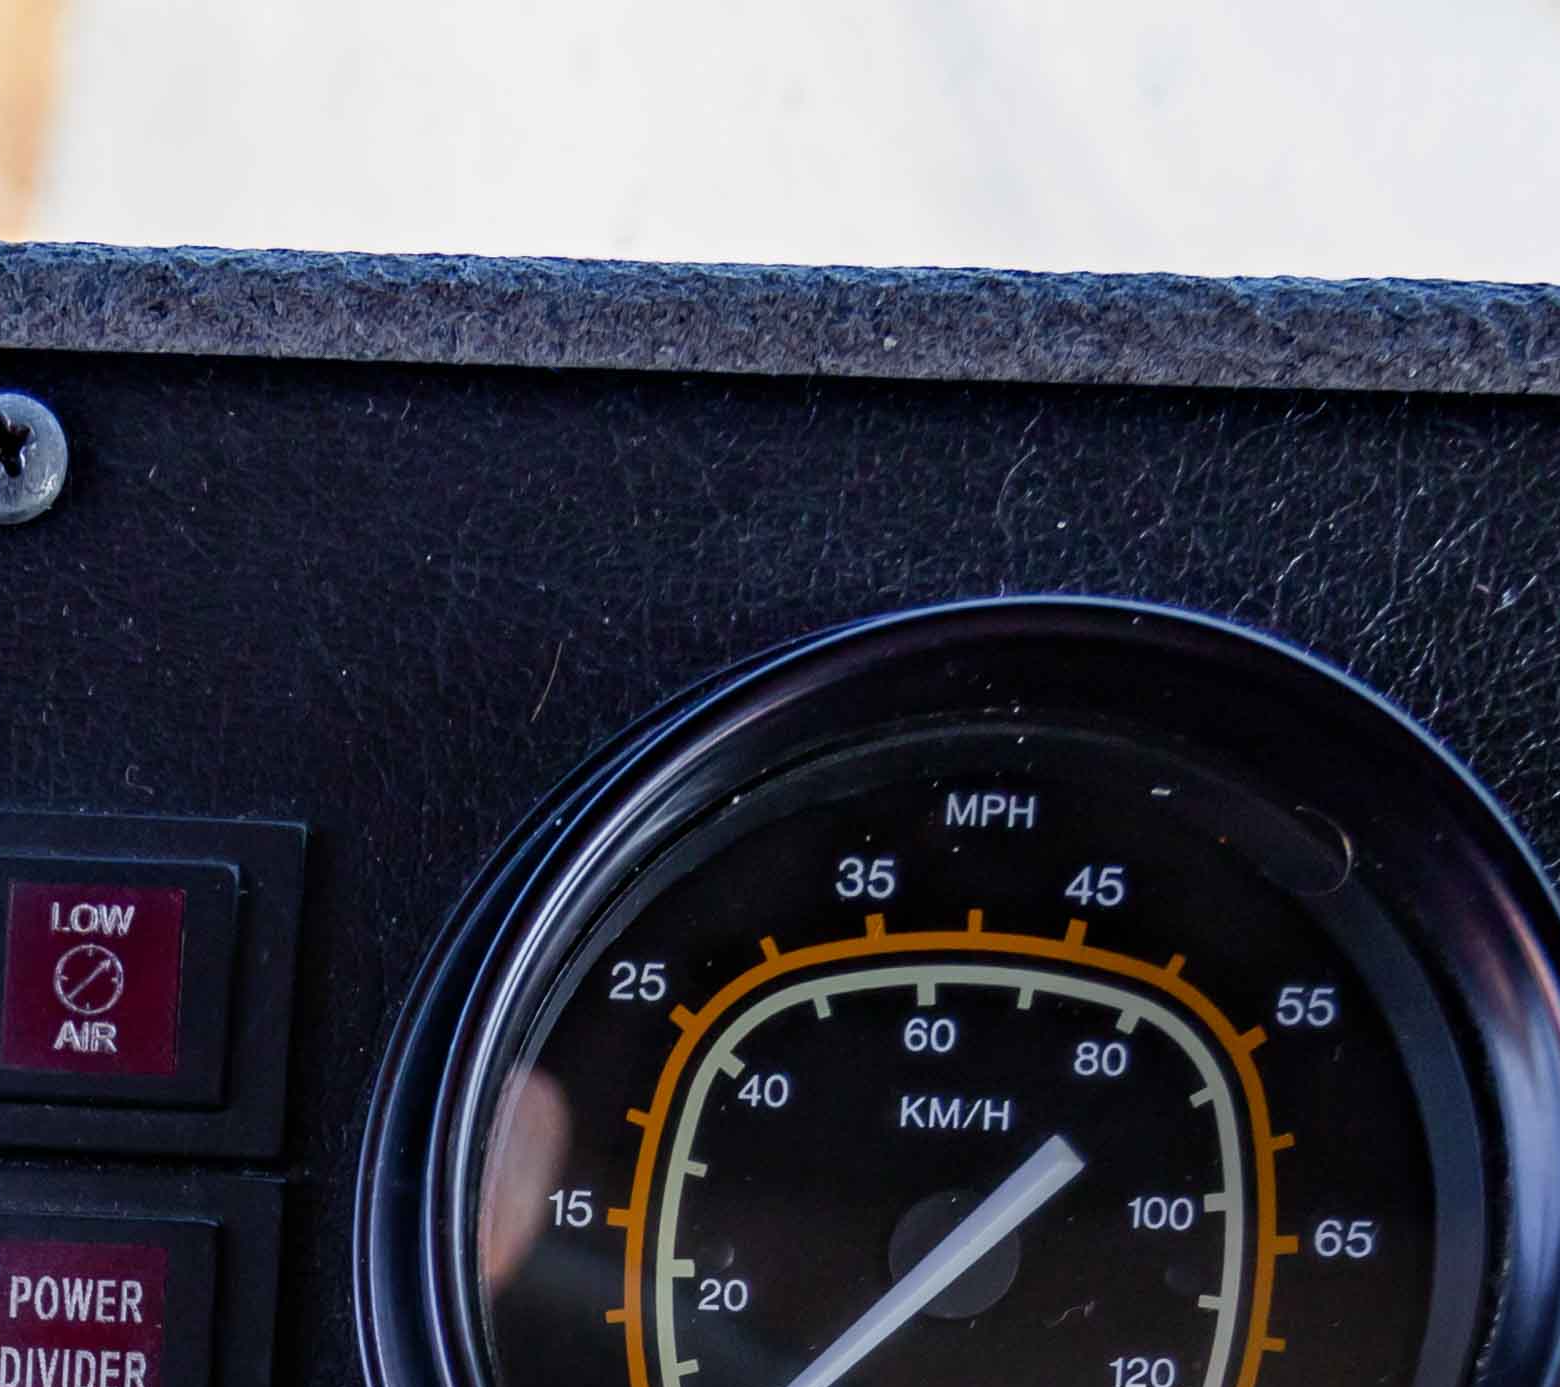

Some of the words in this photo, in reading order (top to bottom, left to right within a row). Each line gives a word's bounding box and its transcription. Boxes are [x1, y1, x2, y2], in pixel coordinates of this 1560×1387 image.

[945, 794, 1036, 830] MPH
[835, 858, 897, 899] 35
[1063, 865, 1126, 908] 45
[49, 900, 136, 937] LOW
[609, 961, 668, 1001] 25
[1275, 986, 1337, 1029] 55
[53, 1020, 119, 1054] AIR
[902, 1018, 958, 1054] 60
[1073, 1041, 1129, 1078] 80
[738, 1073, 791, 1110] 40
[899, 1095, 1013, 1133] KM/H
[547, 1189, 594, 1228] 15
[1127, 1197, 1194, 1231] 100
[1313, 1220, 1375, 1260] 65
[8, 1274, 145, 1325] POWER
[696, 1278, 750, 1313] 20
